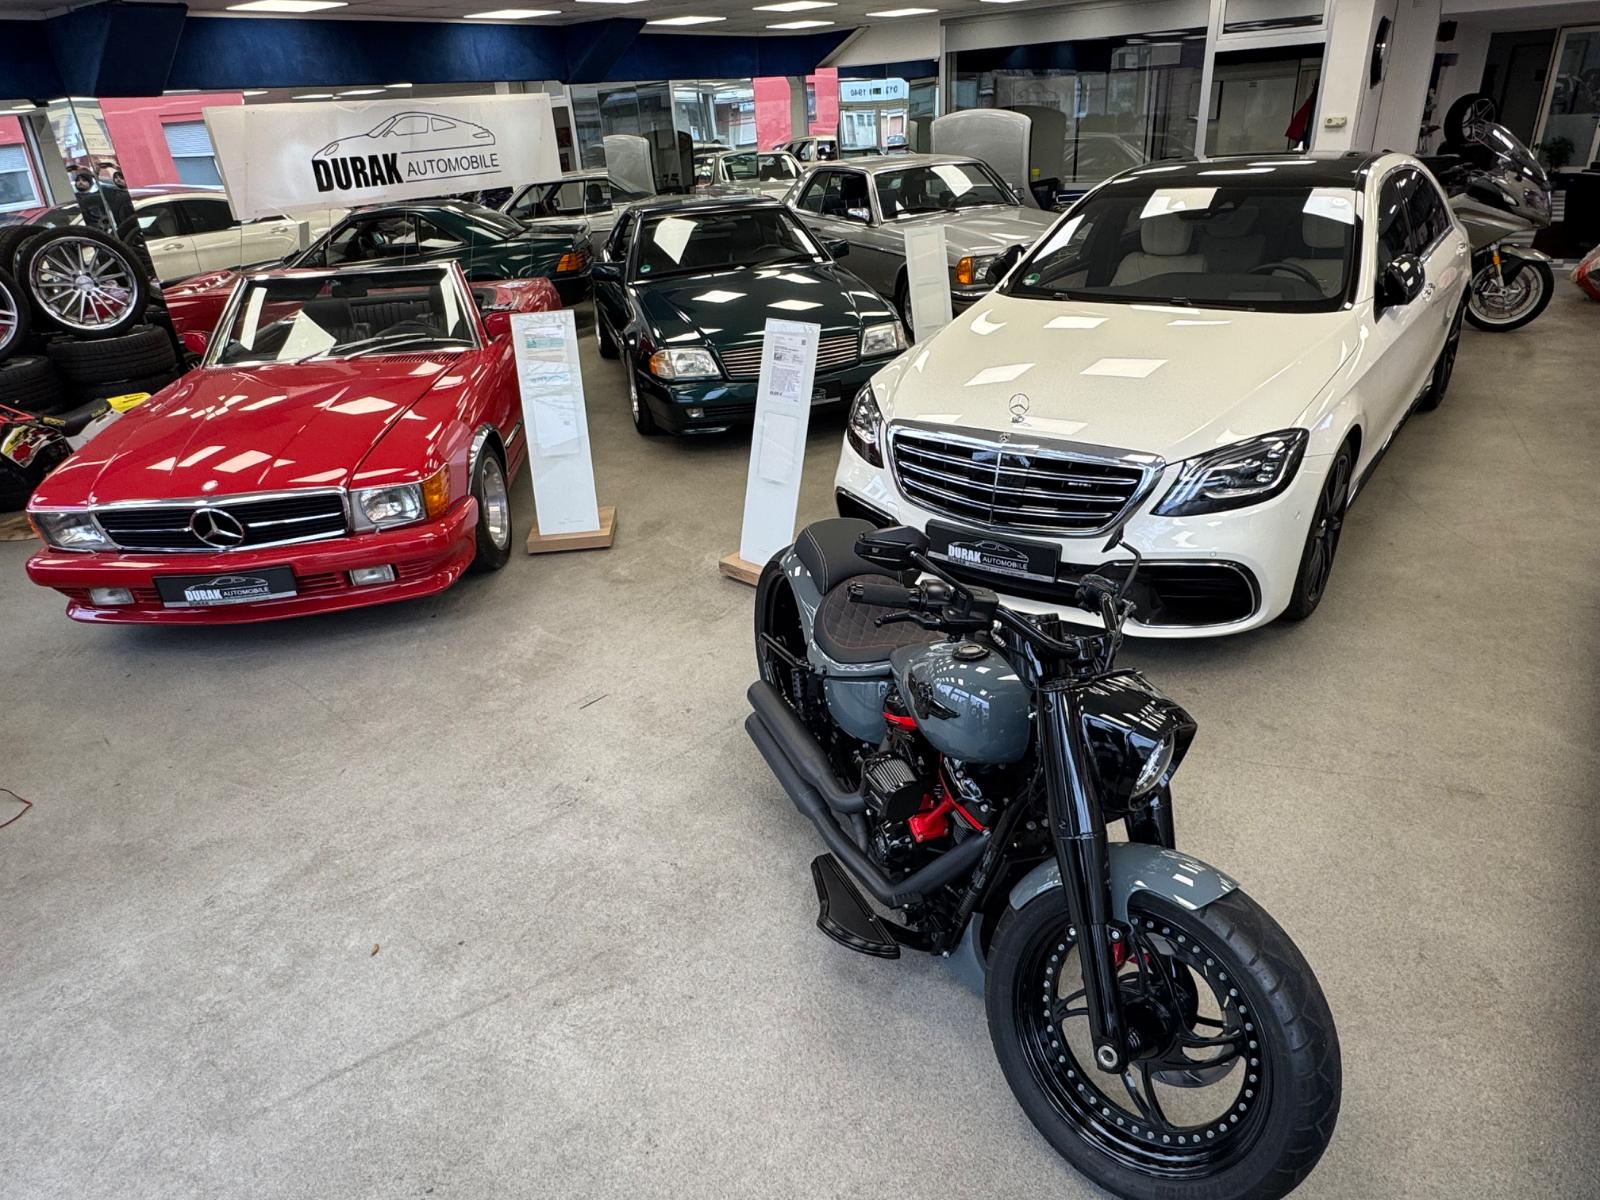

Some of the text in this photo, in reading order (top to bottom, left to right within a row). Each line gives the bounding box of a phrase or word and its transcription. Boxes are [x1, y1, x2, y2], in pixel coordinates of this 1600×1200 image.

[312, 152, 499, 192] DURAK AUTOMOBILE
[948, 544, 981, 563] DURAK
[982, 556, 1028, 570] AUTOMOBILE
[184, 586, 269, 601] DURAK AUTOMOBILE
